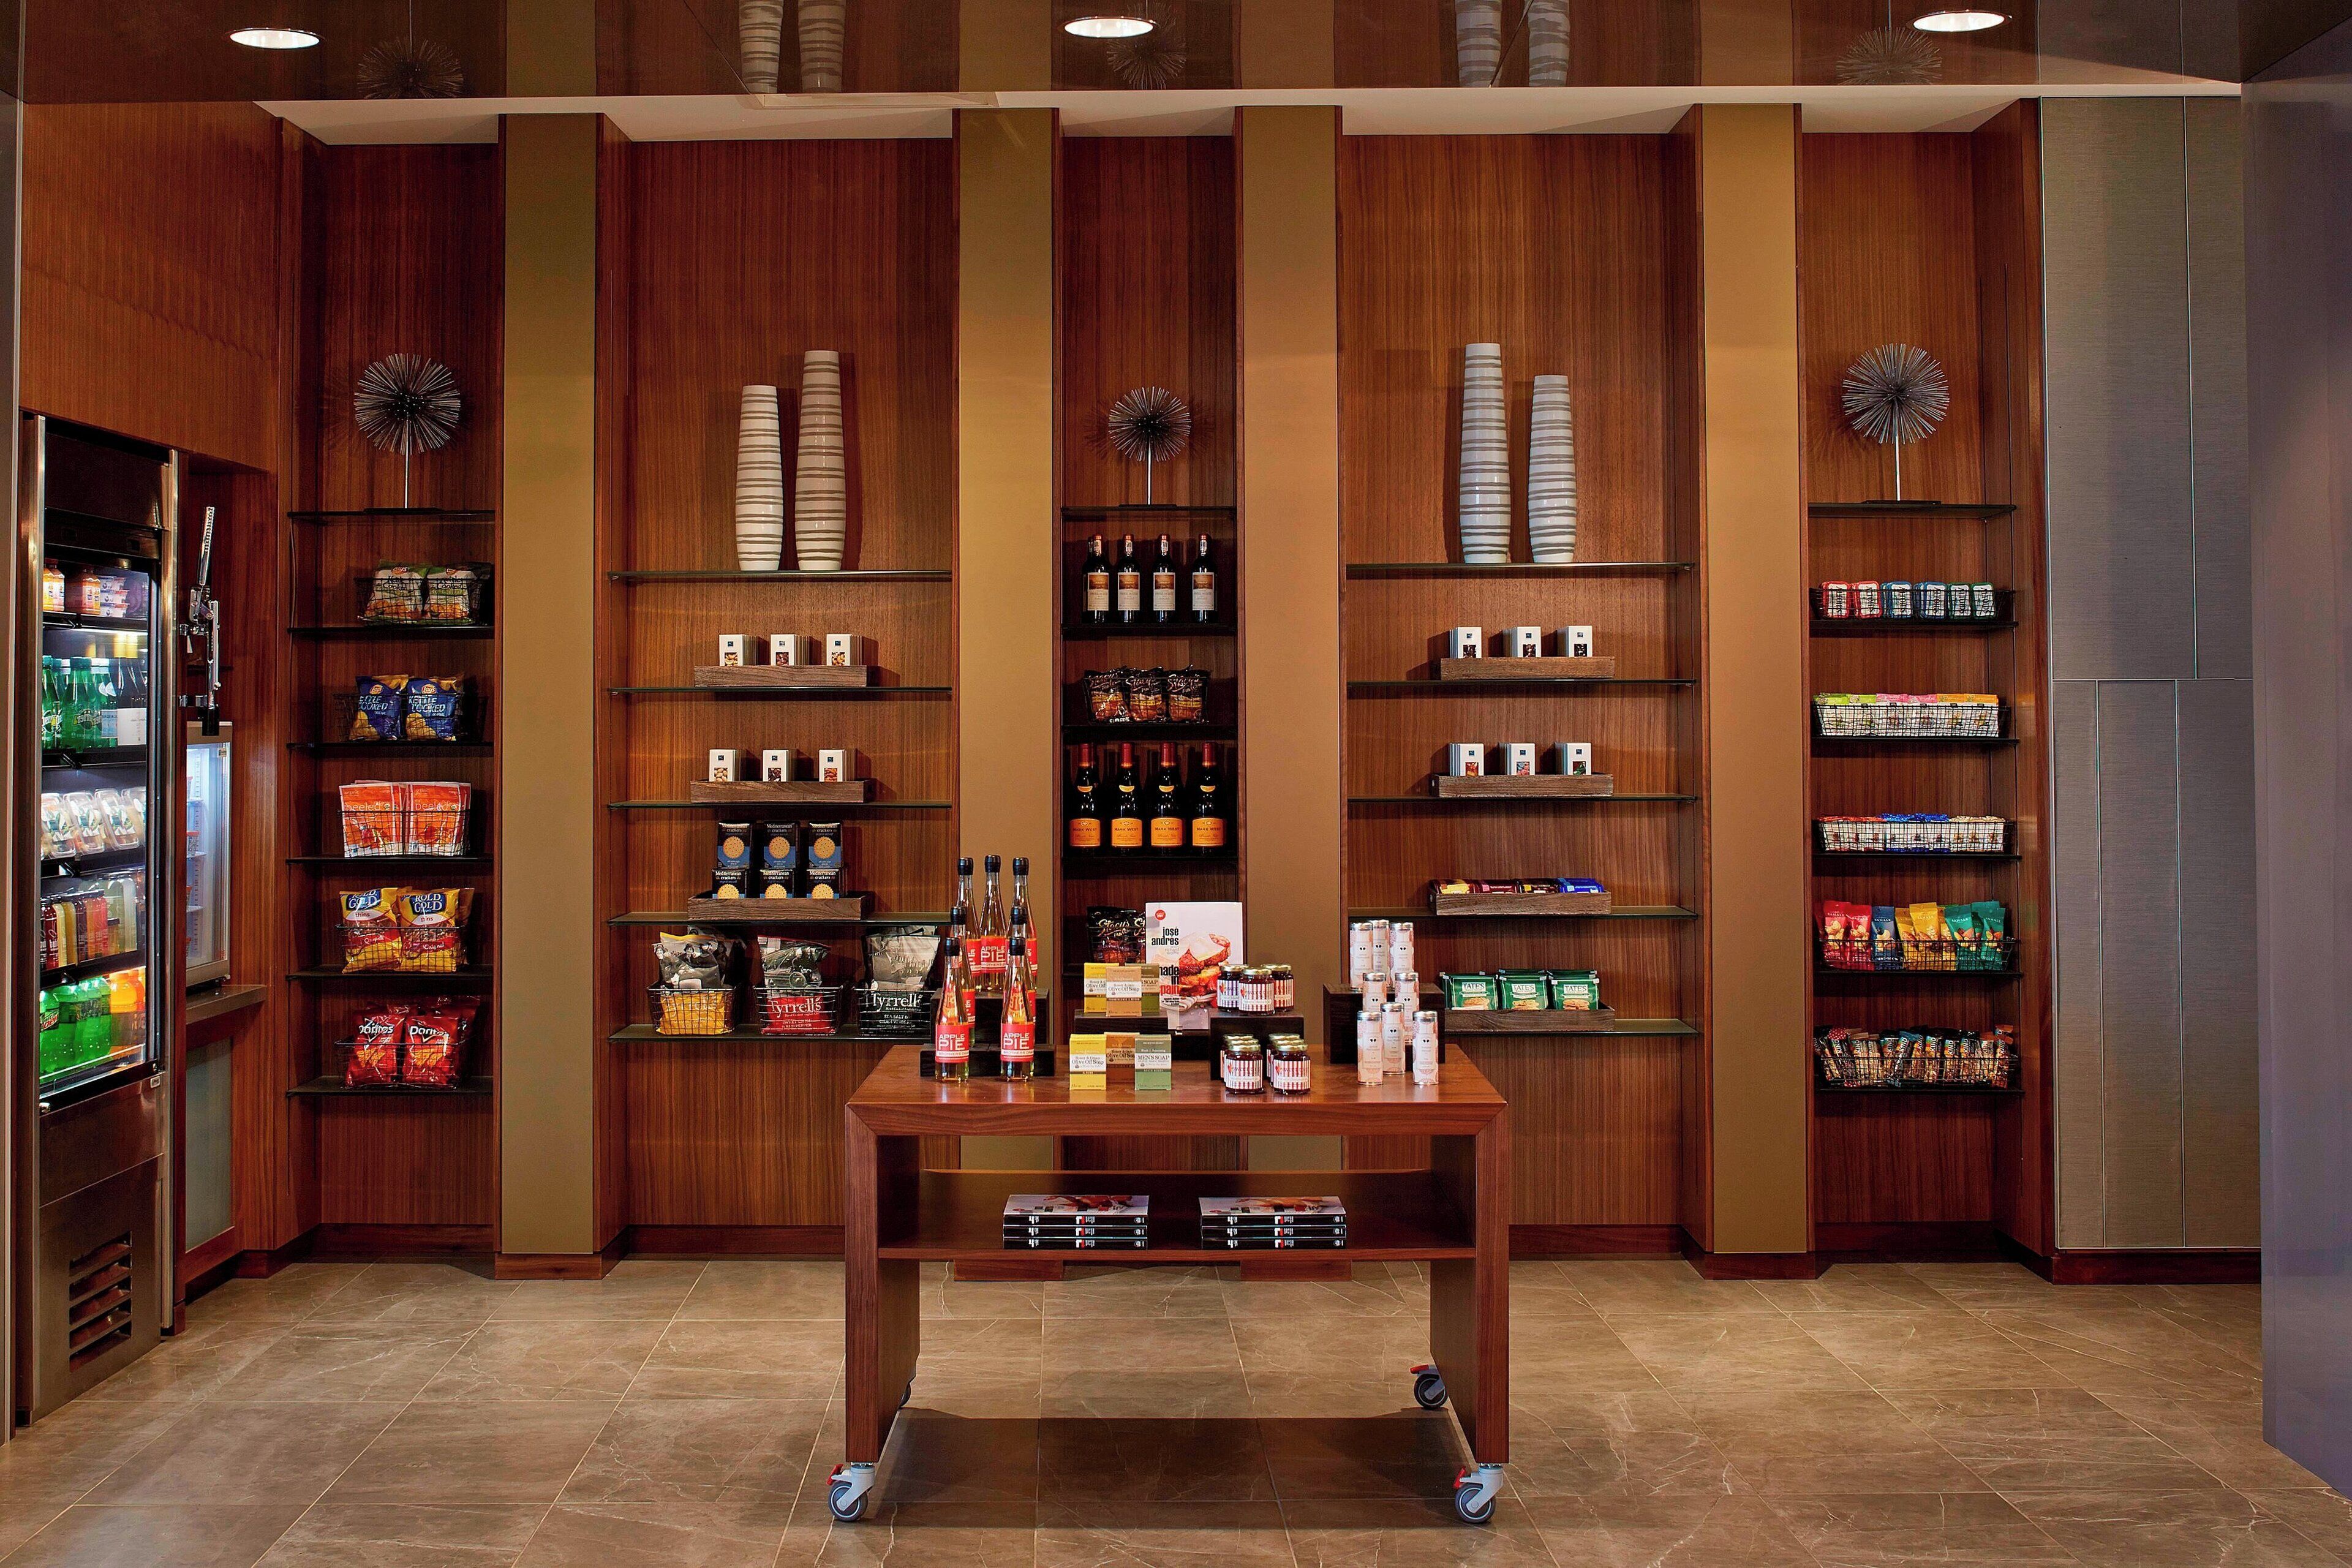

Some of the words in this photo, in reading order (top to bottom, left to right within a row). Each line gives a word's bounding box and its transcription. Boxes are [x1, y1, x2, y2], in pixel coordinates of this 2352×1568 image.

[349, 895, 377, 909] GOLD
[414, 900, 443, 913] GOLD
[1163, 927, 1179, 937] josé
[1152, 937, 1179, 945] andrés
[981, 951, 1005, 962] PIE
[1171, 975, 1179, 985] in
[1159, 984, 1179, 996] pain
[768, 997, 821, 1018] Tyrrell's
[871, 992, 923, 1012] Tyrrell's
[938, 1039, 965, 1050] PIE
[1003, 1038, 1030, 1050] PIE
[1899, 1037, 1908, 1052] KIND
